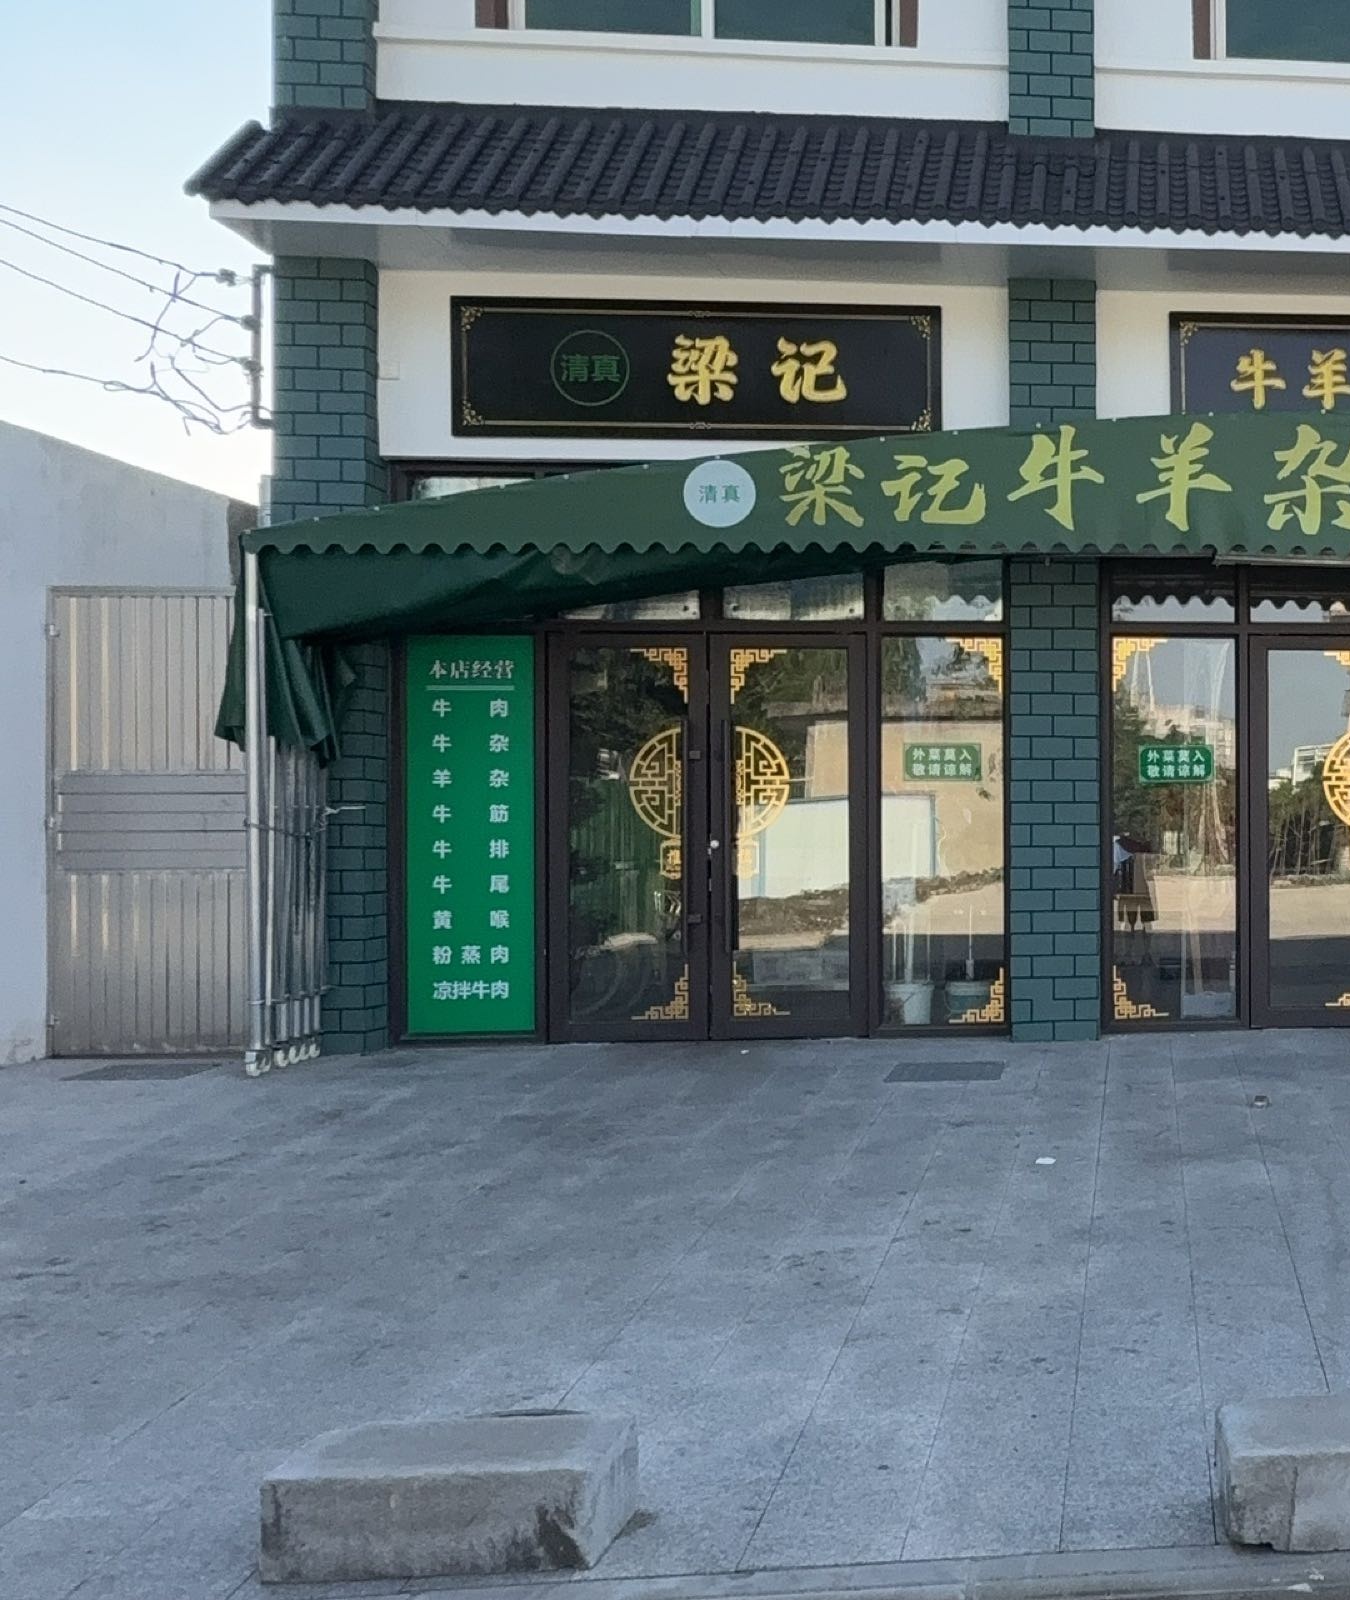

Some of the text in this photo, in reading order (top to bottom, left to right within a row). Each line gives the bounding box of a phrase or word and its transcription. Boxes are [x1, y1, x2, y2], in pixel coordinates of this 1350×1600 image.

[560, 353, 621, 383] 清真
[668, 335, 846, 404] 梁记
[698, 484, 741, 504] 清真
[431, 660, 513, 679] 本店经营
[433, 699, 508, 717] 牛肉
[433, 734, 509, 752] 牛杂
[433, 769, 509, 787] 羊杂
[433, 805, 509, 822] 牛筋
[433, 840, 509, 858] 牛排
[433, 875, 509, 894] 牛尾
[434, 910, 509, 929] 黄喉
[433, 945, 508, 964] 粉蒸肉
[434, 980, 509, 999] 凉拌牛肉
